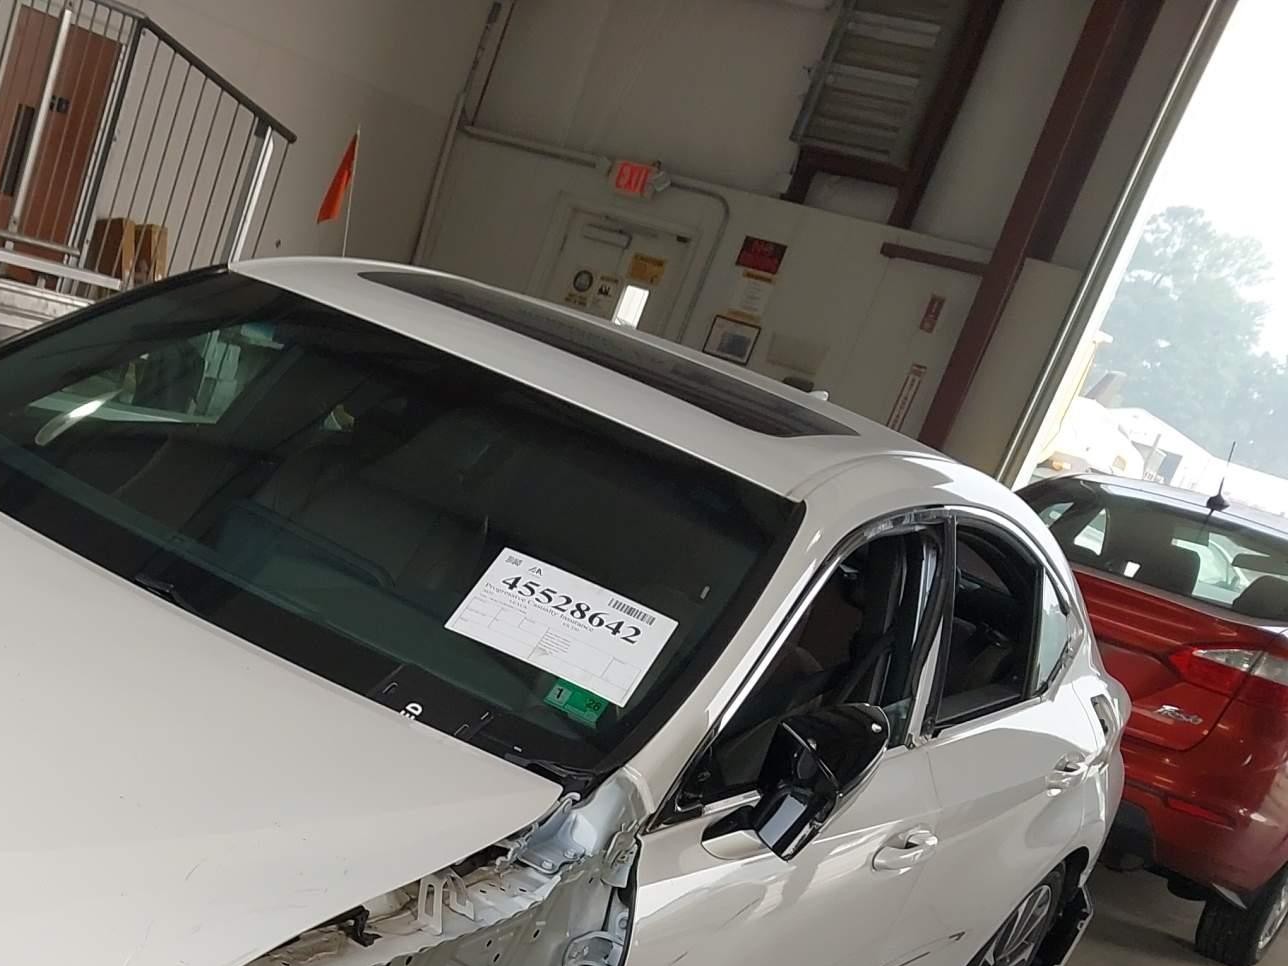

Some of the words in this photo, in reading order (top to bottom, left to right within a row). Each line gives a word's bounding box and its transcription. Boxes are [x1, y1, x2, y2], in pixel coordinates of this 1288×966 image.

[617, 163, 648, 191] EXIT
[501, 576, 641, 644] 45528642
[556, 687, 564, 699] 1
